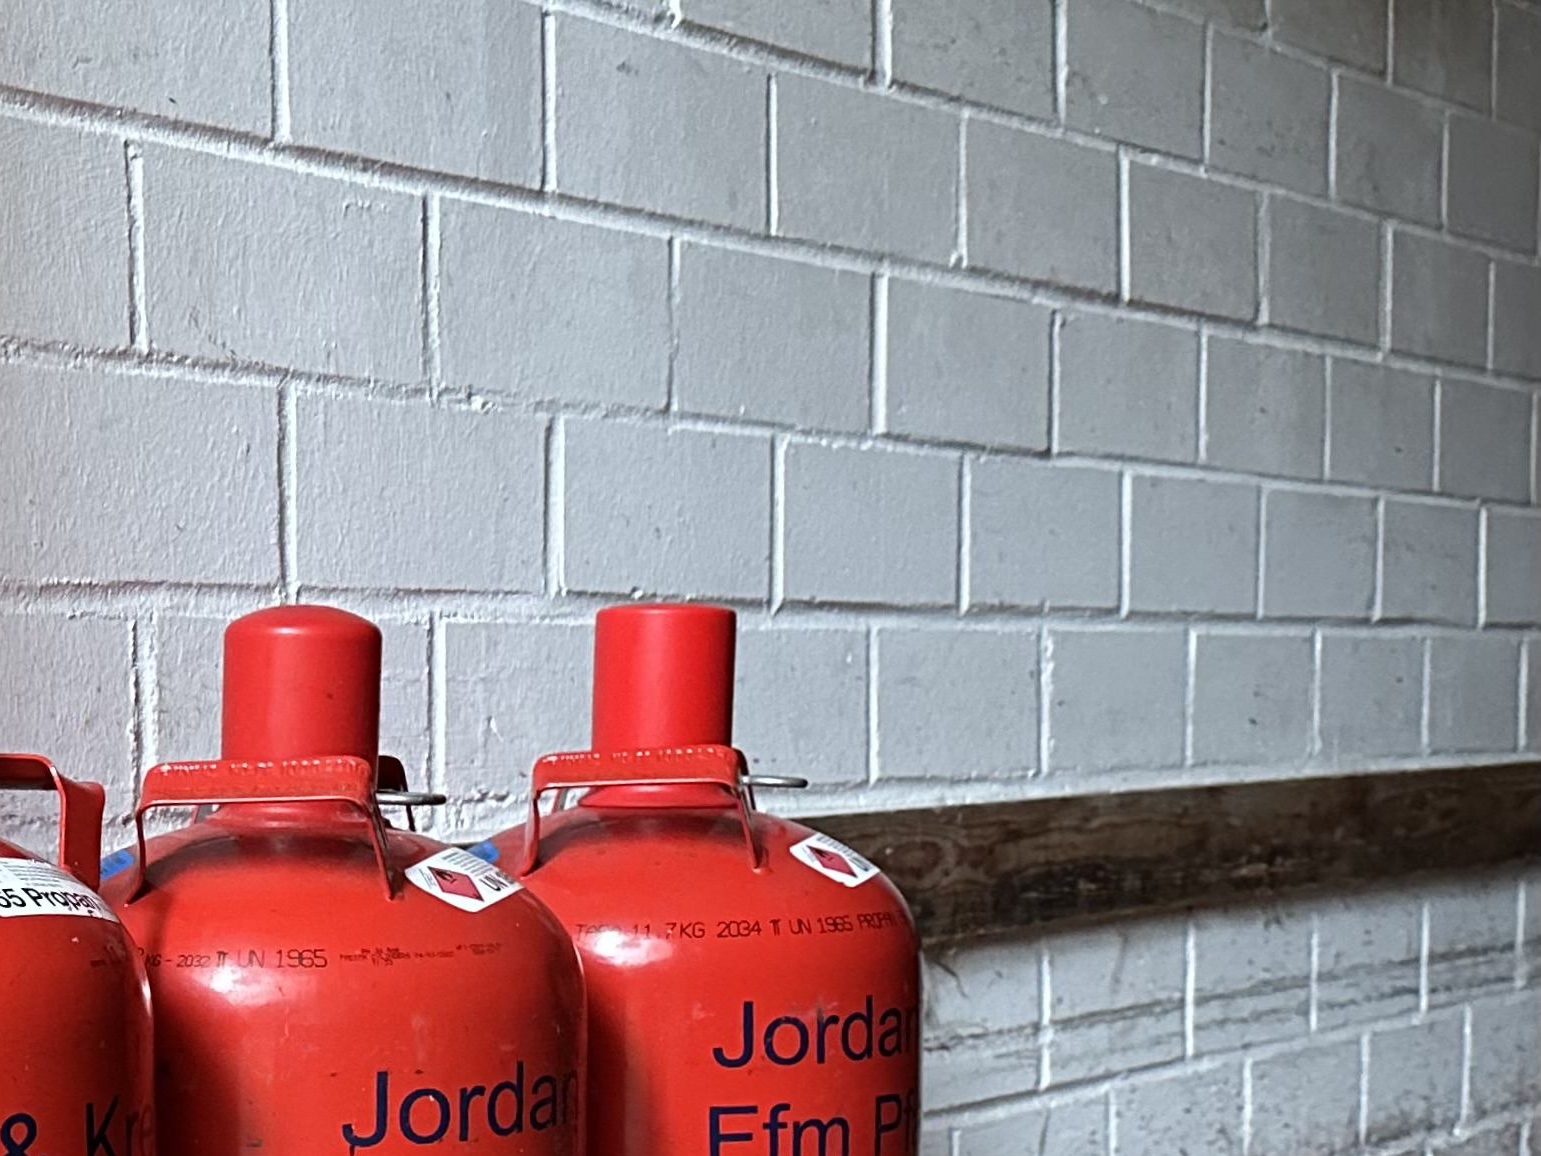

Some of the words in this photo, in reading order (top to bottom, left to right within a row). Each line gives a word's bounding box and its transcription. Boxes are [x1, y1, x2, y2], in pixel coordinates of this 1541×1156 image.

[717, 919, 762, 938] 2034
[789, 918, 813, 935] UN
[817, 915, 854, 934] 1965
[237, 949, 265, 968] UN
[276, 949, 328, 968] 1965
[342, 1061, 579, 1148] Jordan
